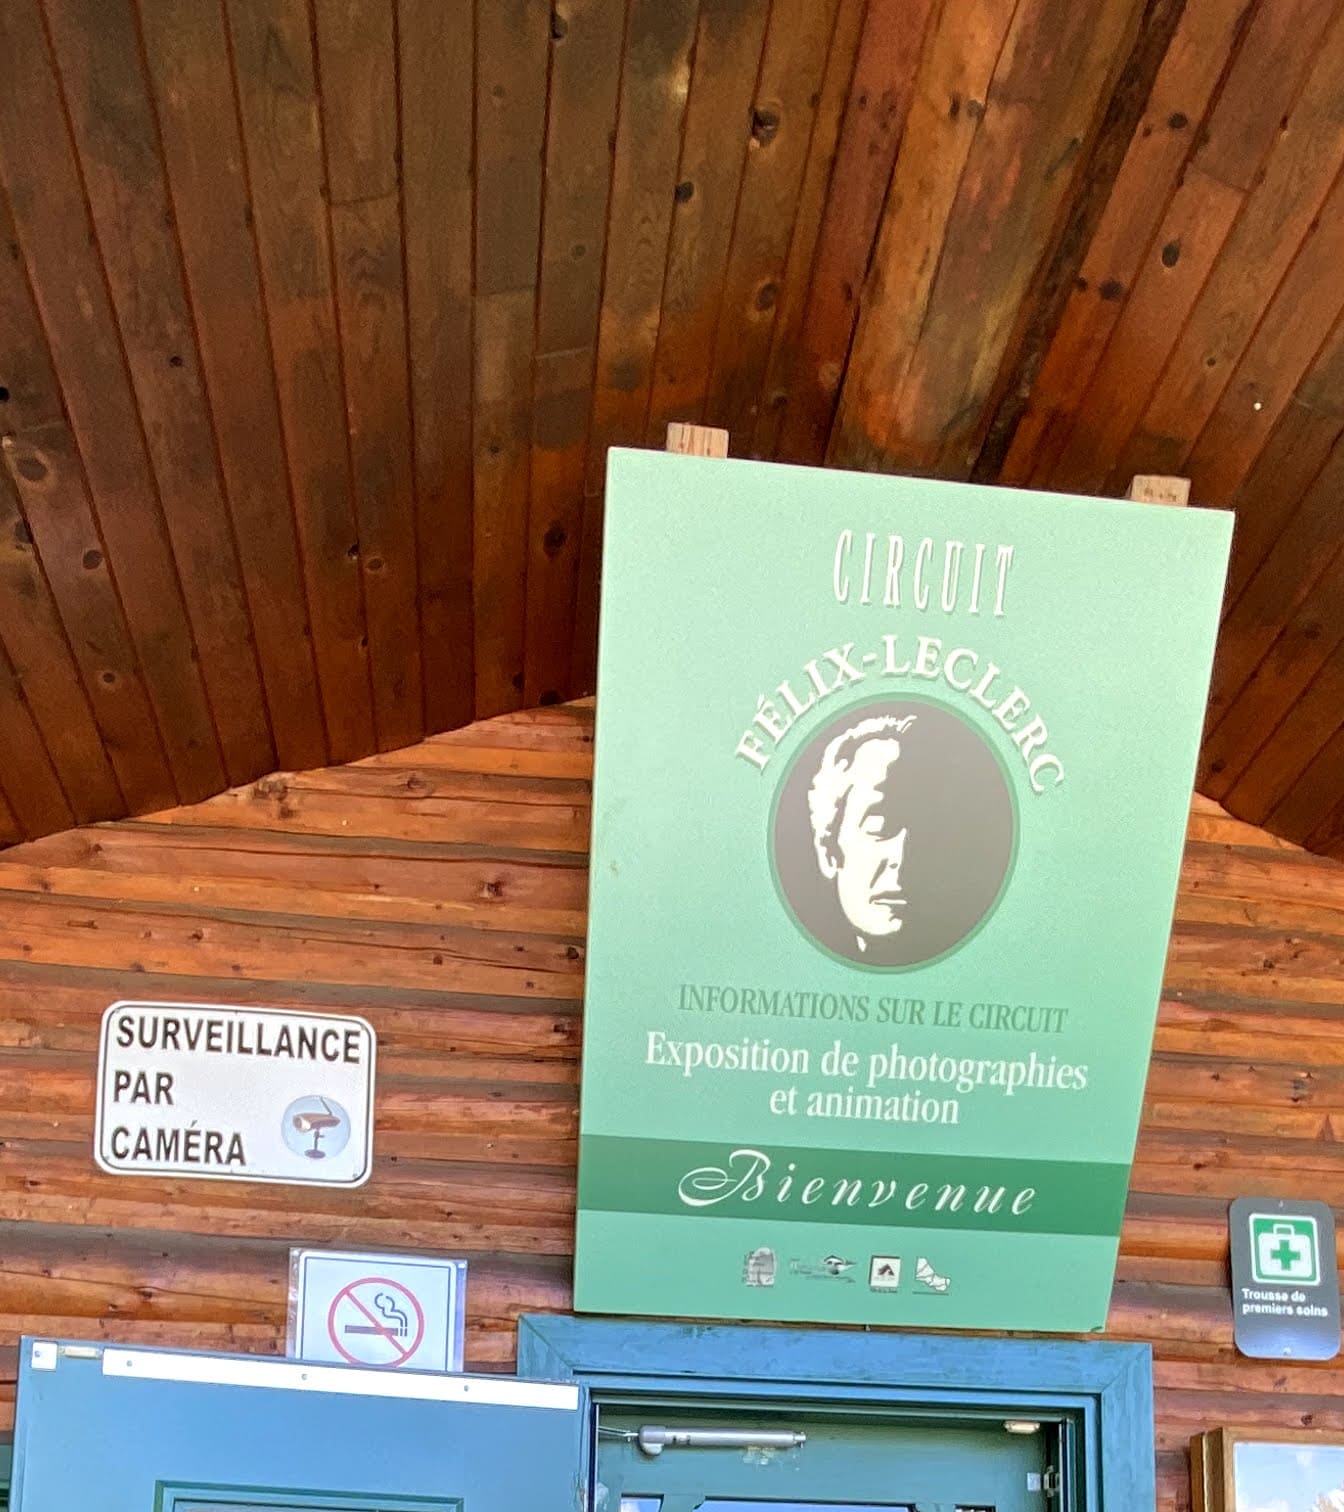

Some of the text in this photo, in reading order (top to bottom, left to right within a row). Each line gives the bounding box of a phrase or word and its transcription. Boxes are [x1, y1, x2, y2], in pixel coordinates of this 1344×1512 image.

[833, 528, 1016, 618] CIRCUIT
[735, 633, 1065, 794] FÉLIX-LECLERC
[678, 983, 1068, 1034] INFORMATIONS SUR LE CIRCUIT
[116, 1014, 362, 1064] SURVEILLANCE
[645, 1030, 1089, 1096] Exposition de photographies
[113, 1069, 175, 1105] PAR
[769, 1089, 959, 1125] et animation
[110, 1120, 247, 1166] CAMÉRA
[677, 1148, 1037, 1216] Bienvenue
[1241, 1288, 1306, 1302] Trousse de
[1242, 1303, 1328, 1316] premiers soins
